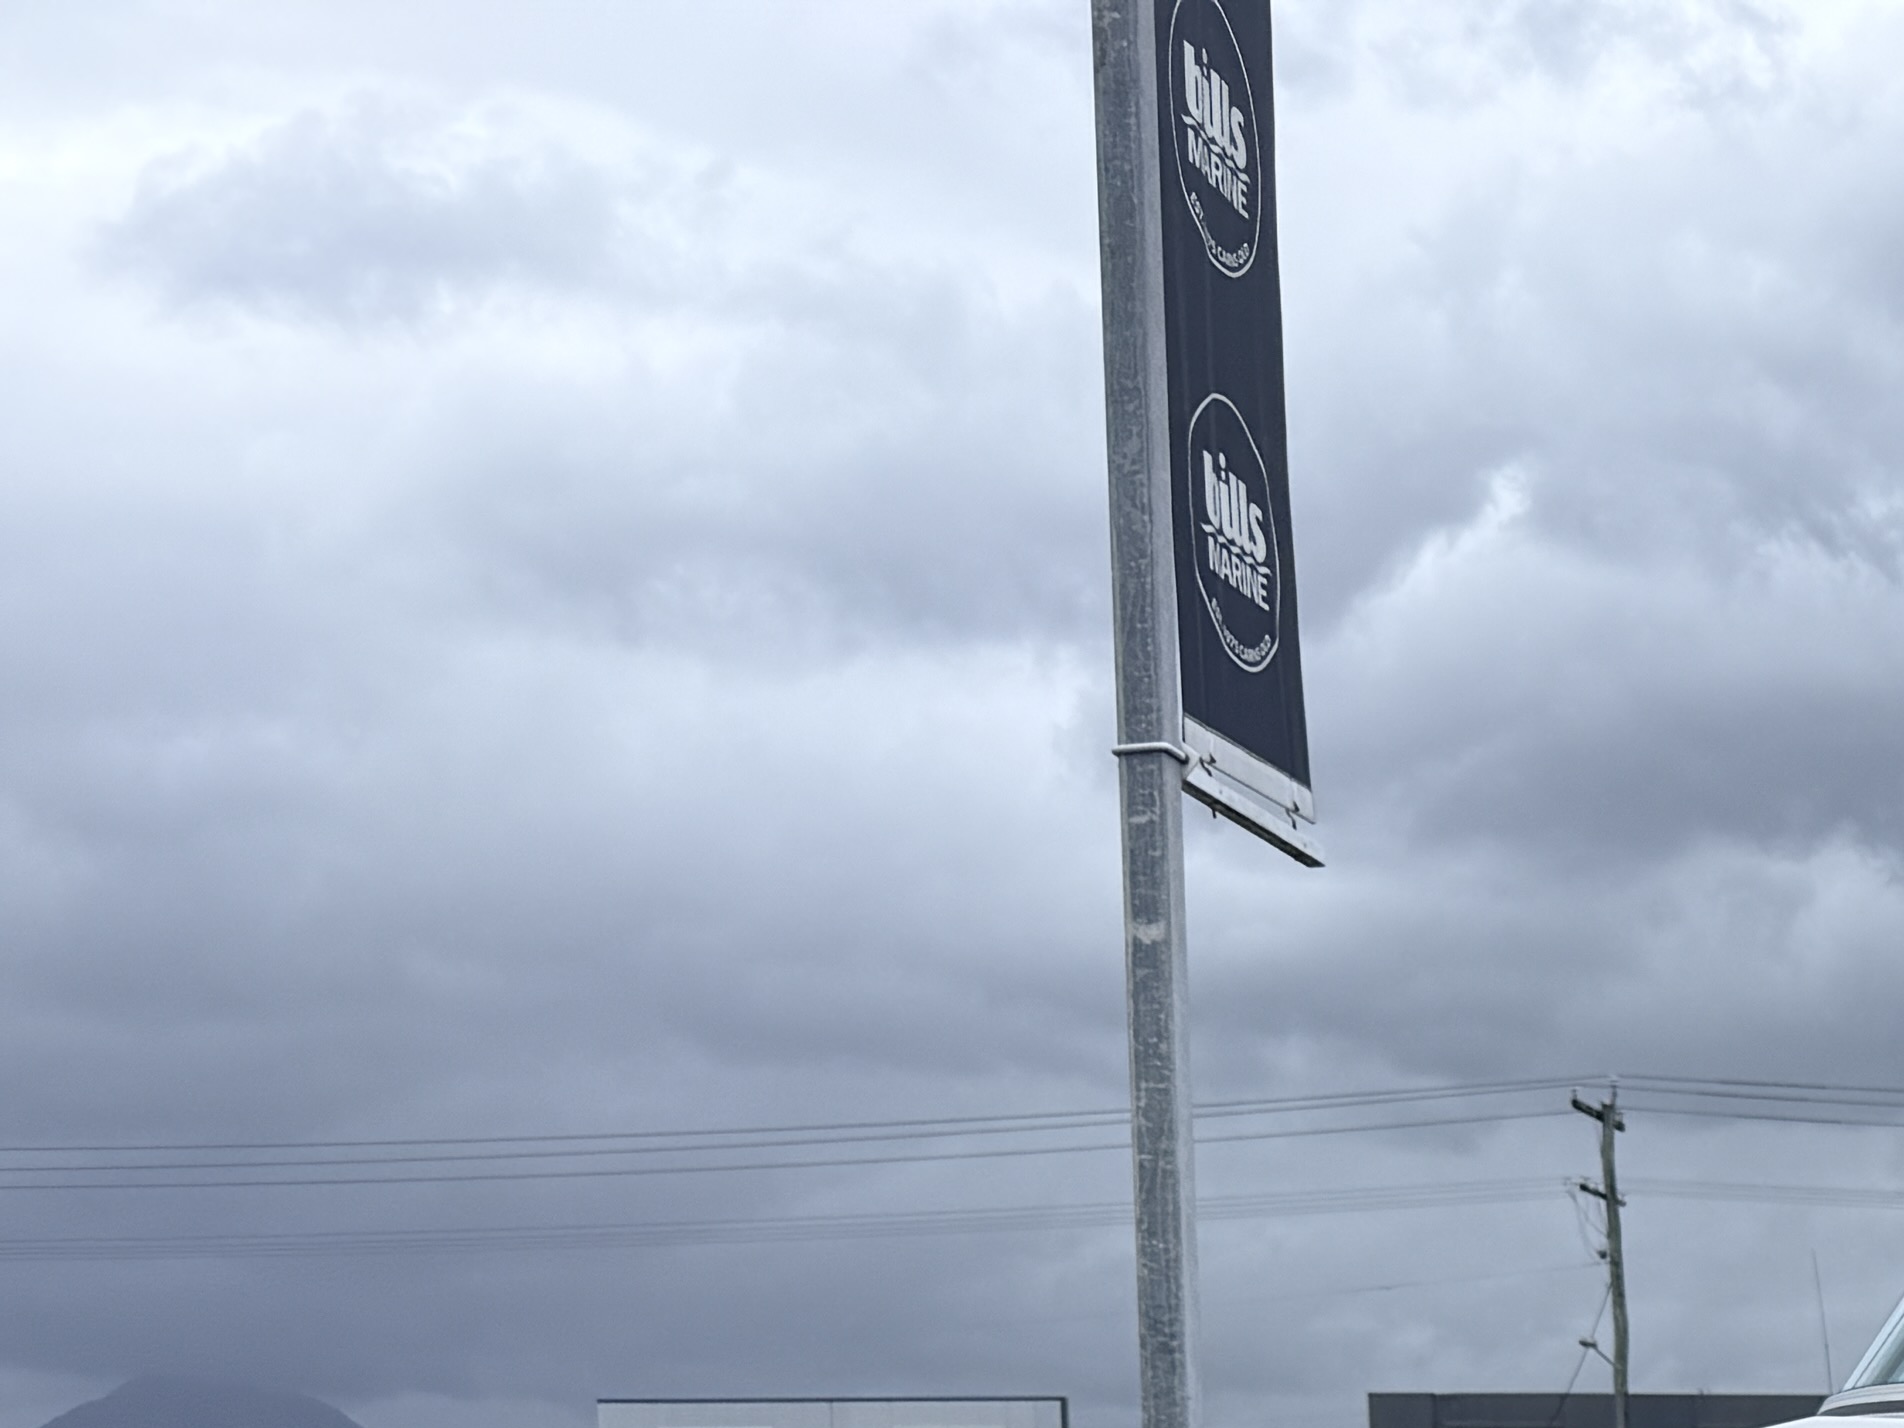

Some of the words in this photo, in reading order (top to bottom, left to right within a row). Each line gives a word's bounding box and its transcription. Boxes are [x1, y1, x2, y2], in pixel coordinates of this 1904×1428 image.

[1183, 39, 1248, 170] bills
[1187, 127, 1250, 220] MARINE
[1202, 450, 1268, 563] bills
[1207, 535, 1270, 612] MARINE
